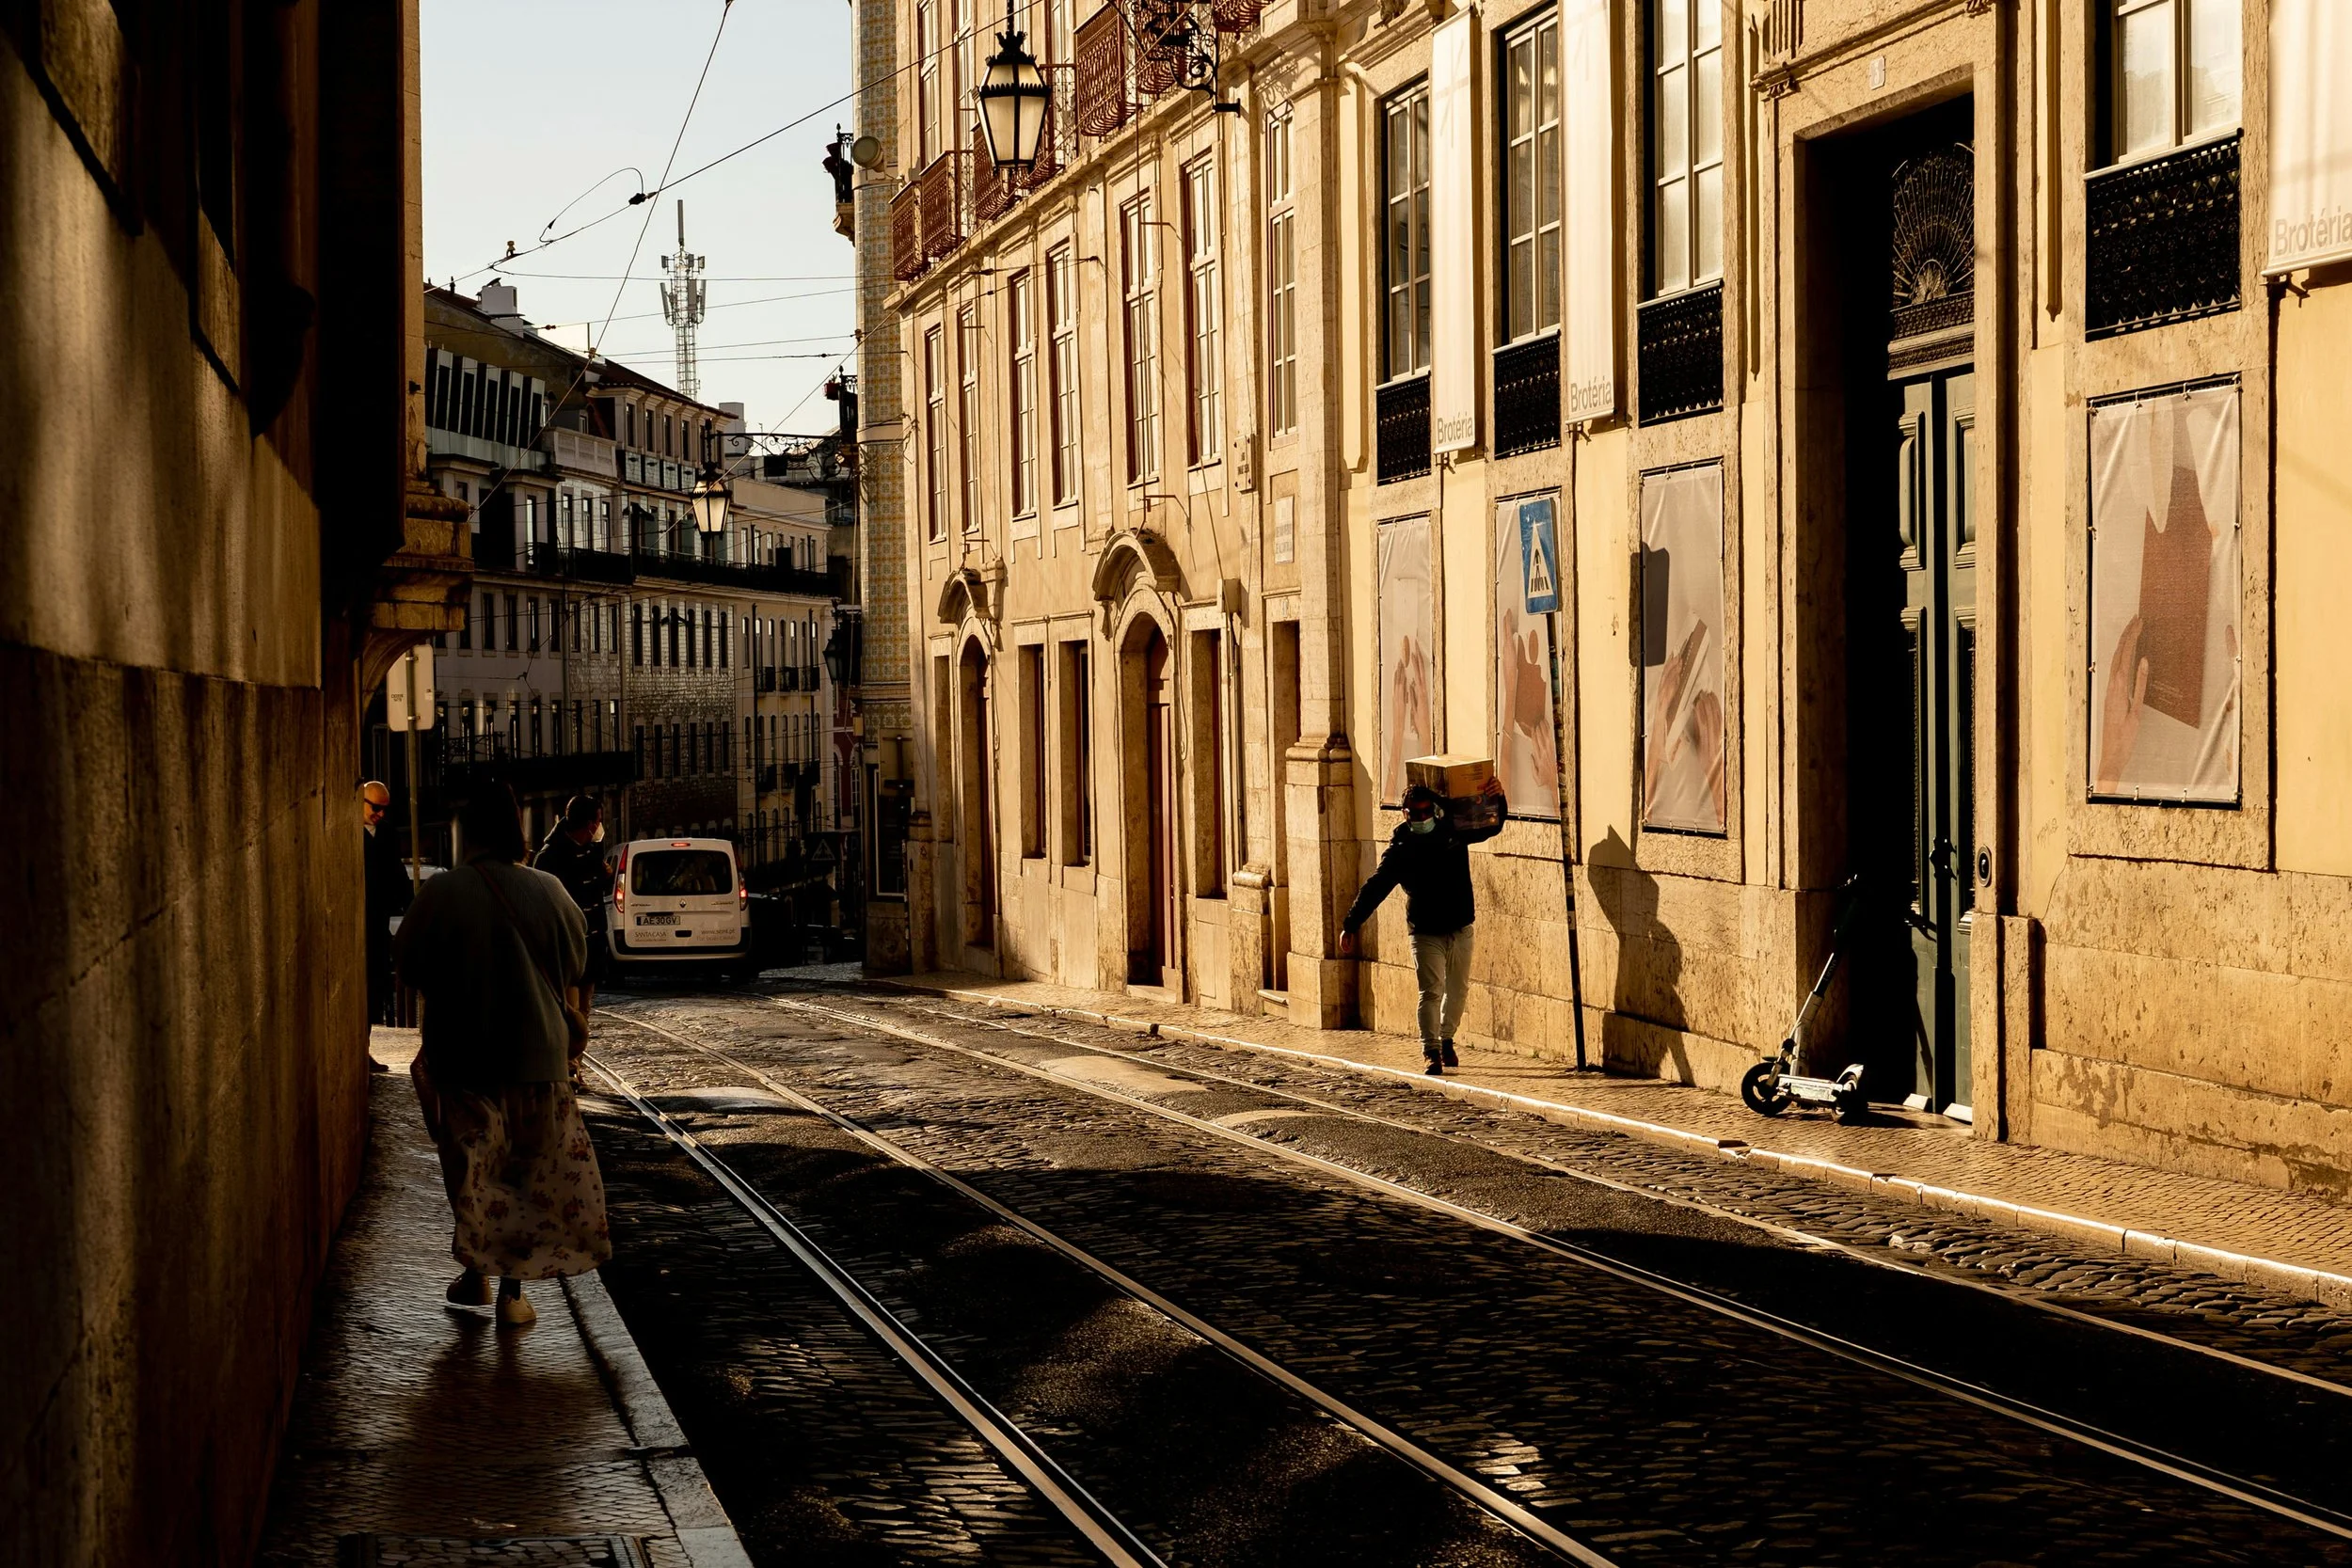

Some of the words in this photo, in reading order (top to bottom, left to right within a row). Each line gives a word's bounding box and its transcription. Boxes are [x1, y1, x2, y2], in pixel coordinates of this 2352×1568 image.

[2275, 205, 2352, 257] Brotéria
[1570, 375, 1613, 413] Brotéria
[1437, 412, 1473, 444] Brotéria
